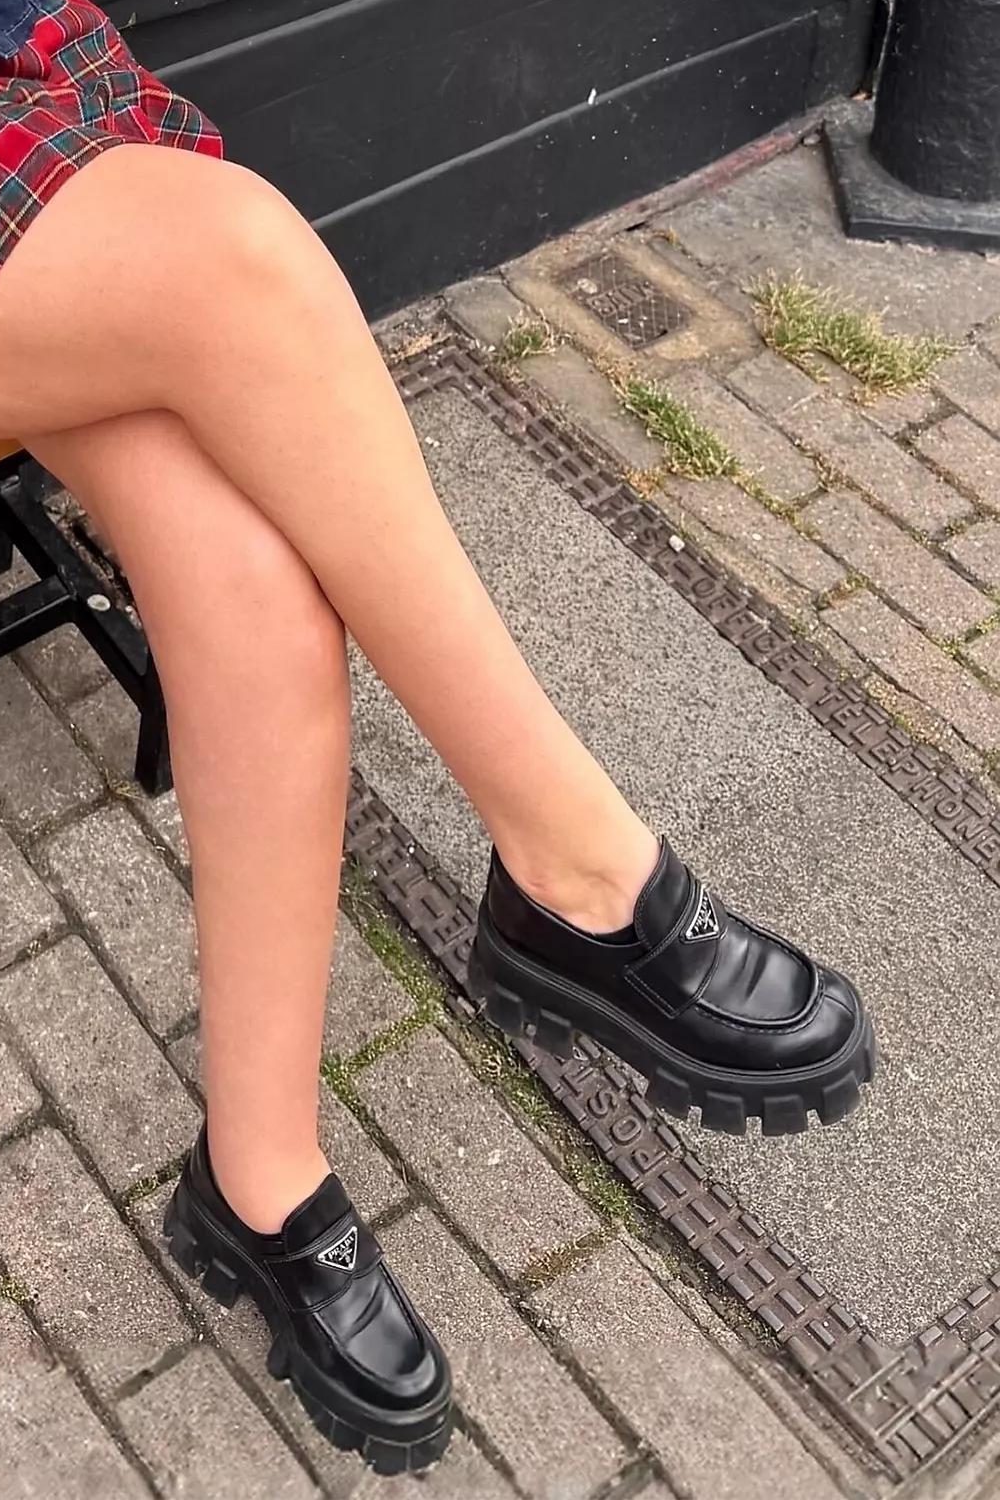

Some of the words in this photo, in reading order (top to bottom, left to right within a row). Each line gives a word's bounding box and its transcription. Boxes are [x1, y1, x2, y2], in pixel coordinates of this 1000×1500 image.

[599, 490, 684, 560] POST
[691, 577, 797, 671] OFFICE
[561, 1065, 667, 1174] POST
[328, 1235, 354, 1260] PRADA
